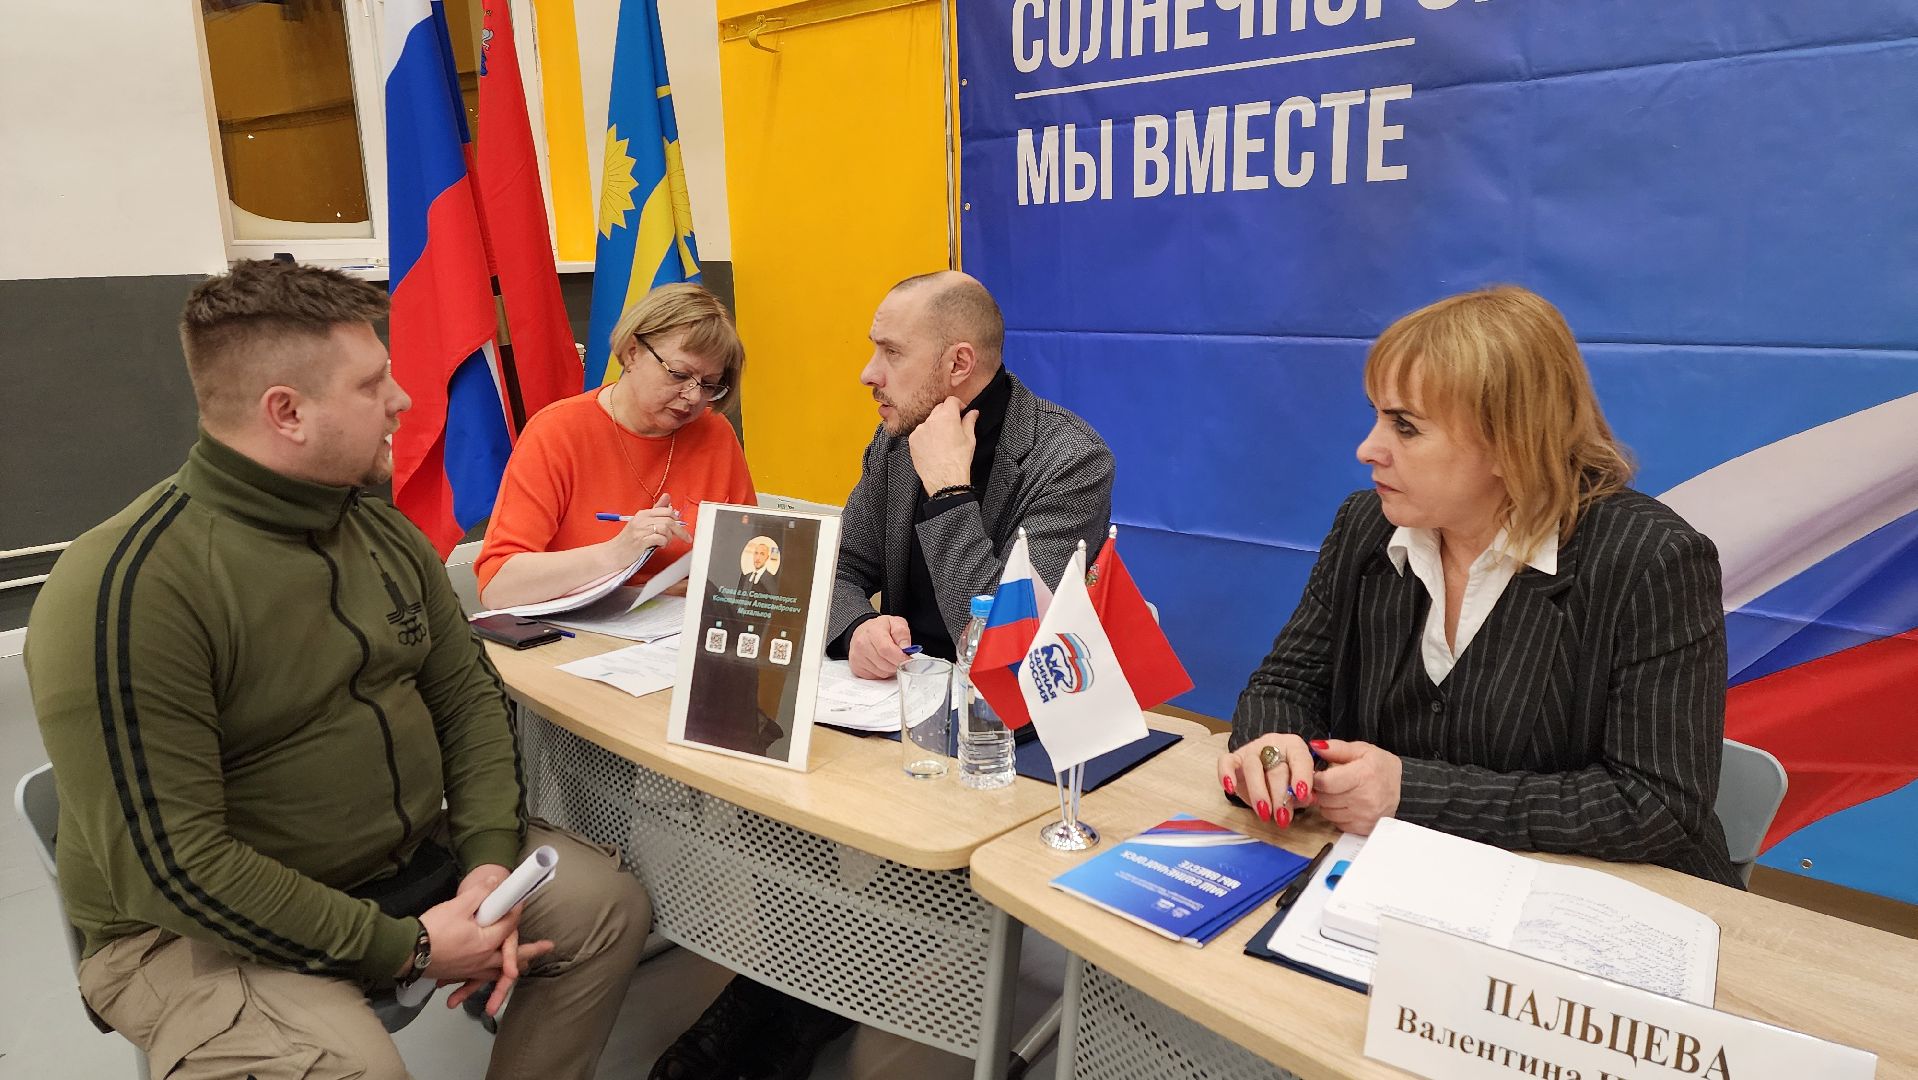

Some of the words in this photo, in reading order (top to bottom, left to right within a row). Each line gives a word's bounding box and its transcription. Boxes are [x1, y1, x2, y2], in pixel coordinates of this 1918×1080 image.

[1016, 119, 1113, 206] МЫ
[1132, 84, 1413, 199] ВМЕСТЕ
[1394, 1004, 1583, 1080] Валентина
[1483, 975, 1733, 1080] ПАЛЬЦЕВА
